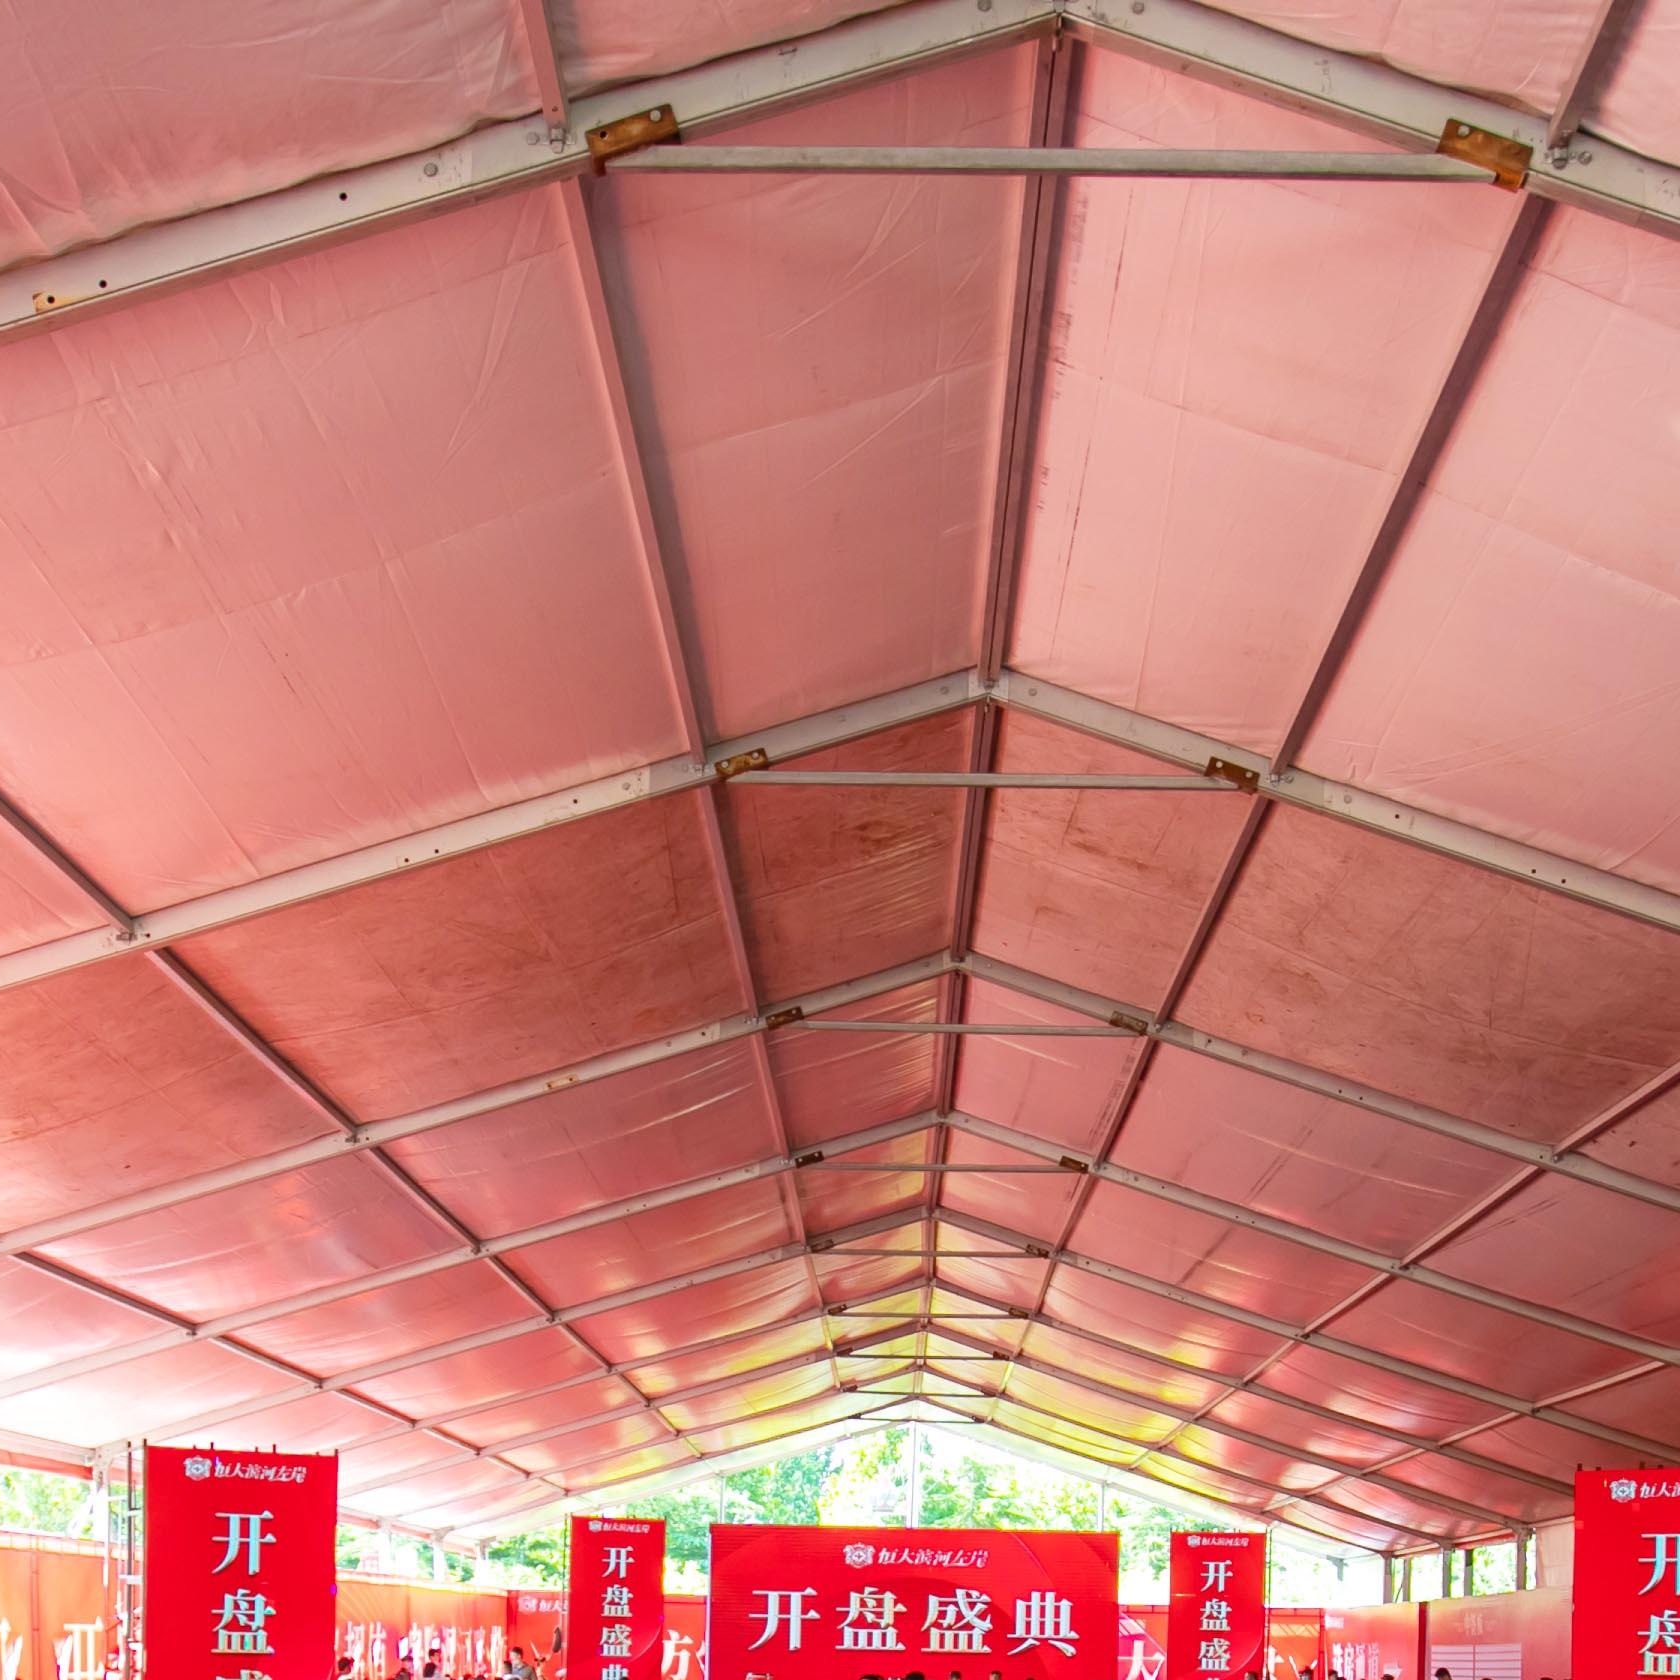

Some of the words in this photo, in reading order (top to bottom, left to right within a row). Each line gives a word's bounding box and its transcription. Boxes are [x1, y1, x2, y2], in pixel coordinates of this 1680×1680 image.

[213, 1459, 307, 1484] 恒大滨河左岸
[877, 1548, 990, 1569] 恒大滨河左岸
[748, 1587, 1081, 1657] 开盘盛典
